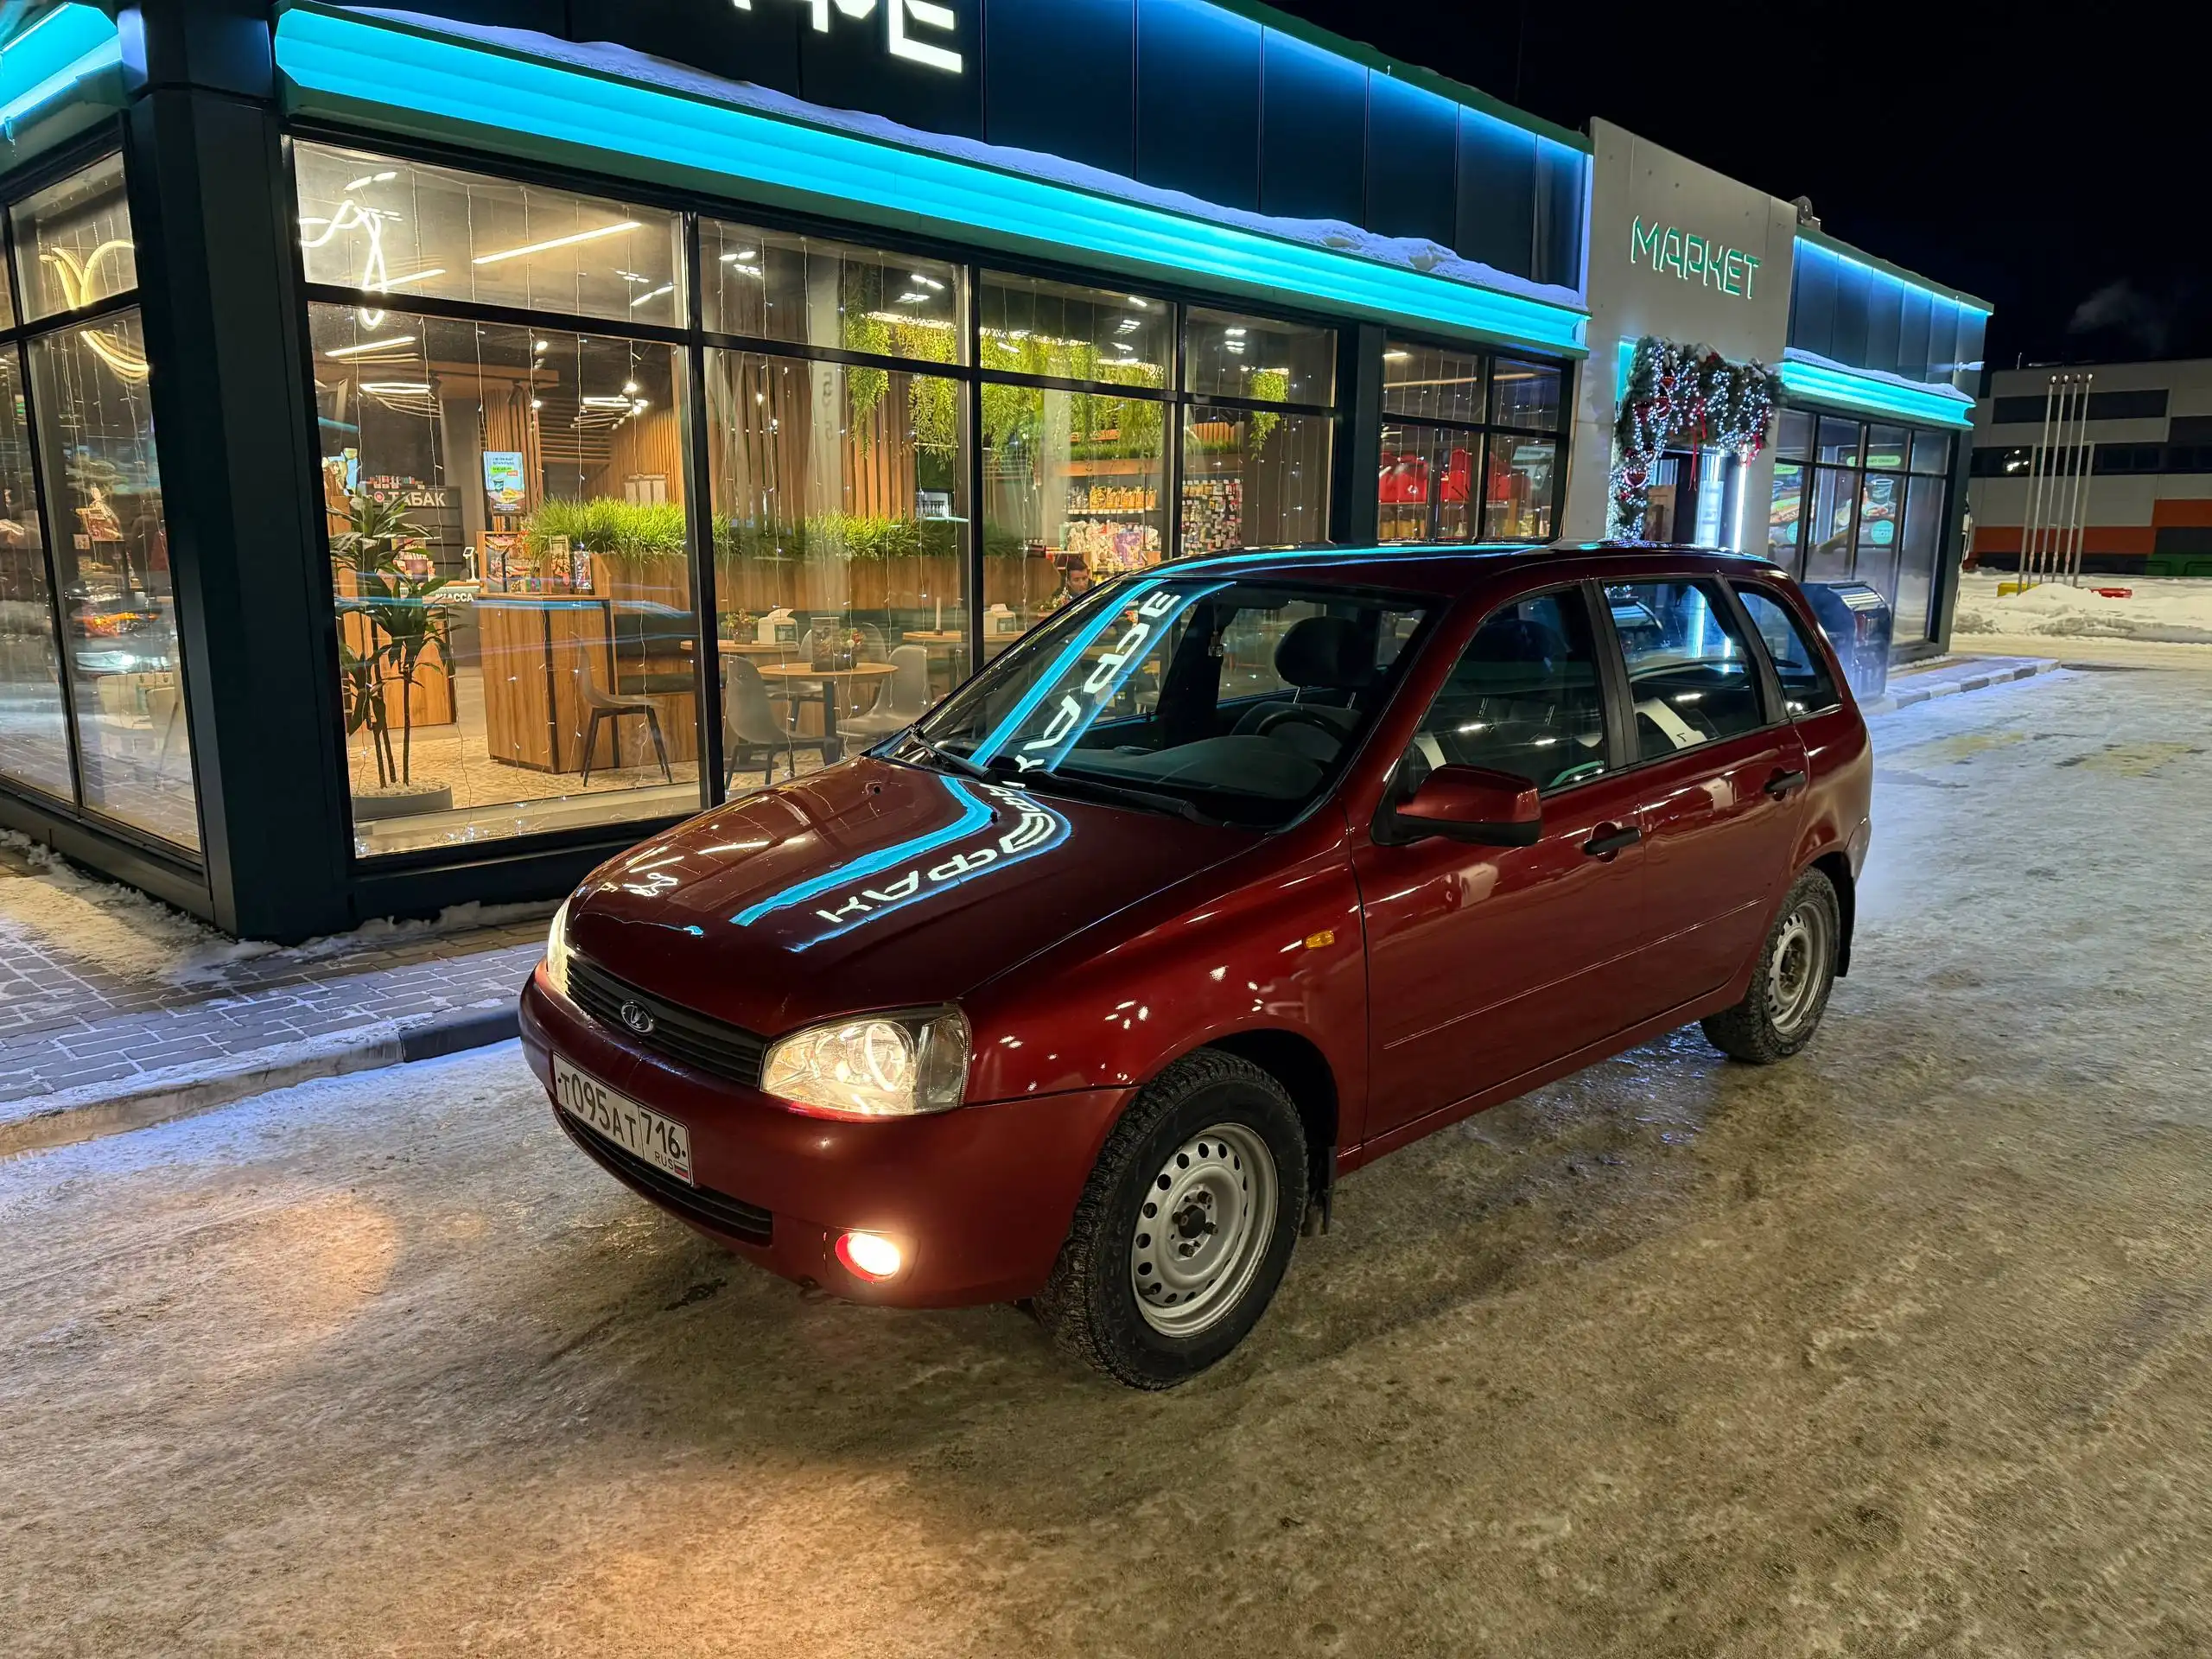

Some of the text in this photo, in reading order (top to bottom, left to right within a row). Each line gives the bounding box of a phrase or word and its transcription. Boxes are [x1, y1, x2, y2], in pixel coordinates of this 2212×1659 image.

[1630, 214, 1763, 300] МАРКЕТ
[640, 1111, 681, 1160] 716
[655, 1151, 673, 1170] RUS
